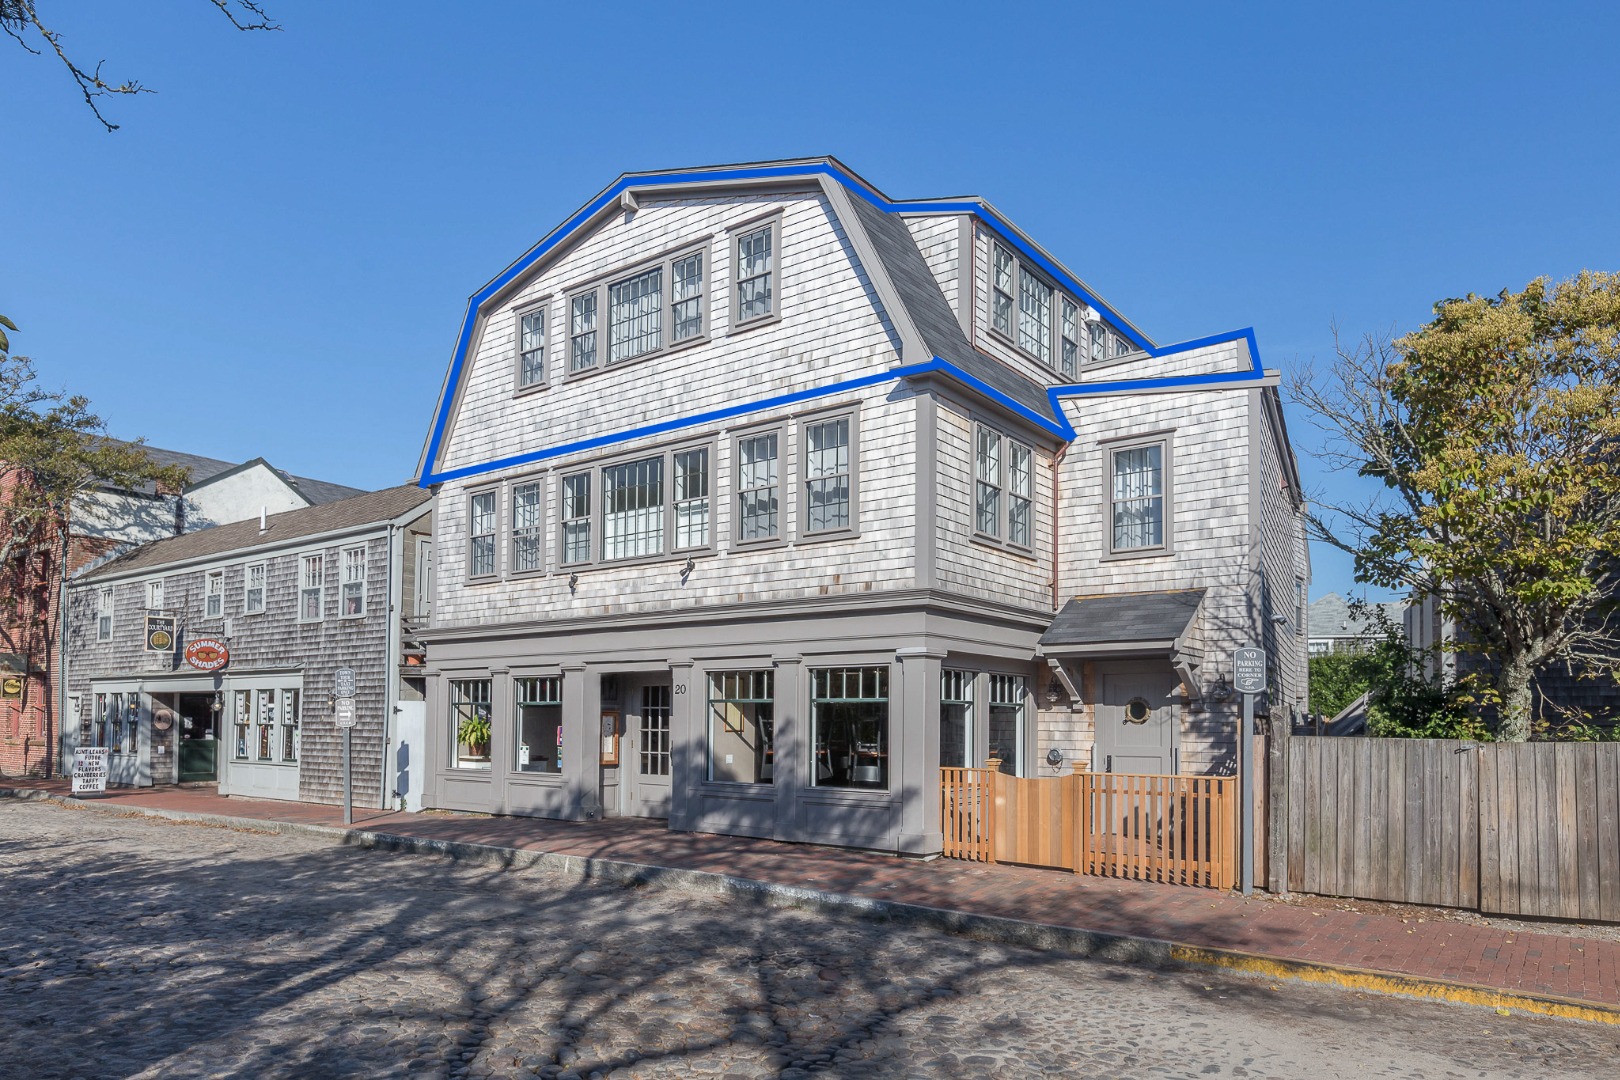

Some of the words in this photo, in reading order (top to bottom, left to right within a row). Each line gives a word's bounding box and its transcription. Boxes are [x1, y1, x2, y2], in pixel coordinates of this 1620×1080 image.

[189, 640, 225, 654] SUMMER
[1243, 651, 1257, 659] NO
[189, 656, 225, 669] SHADES
[674, 684, 687, 695] 20
